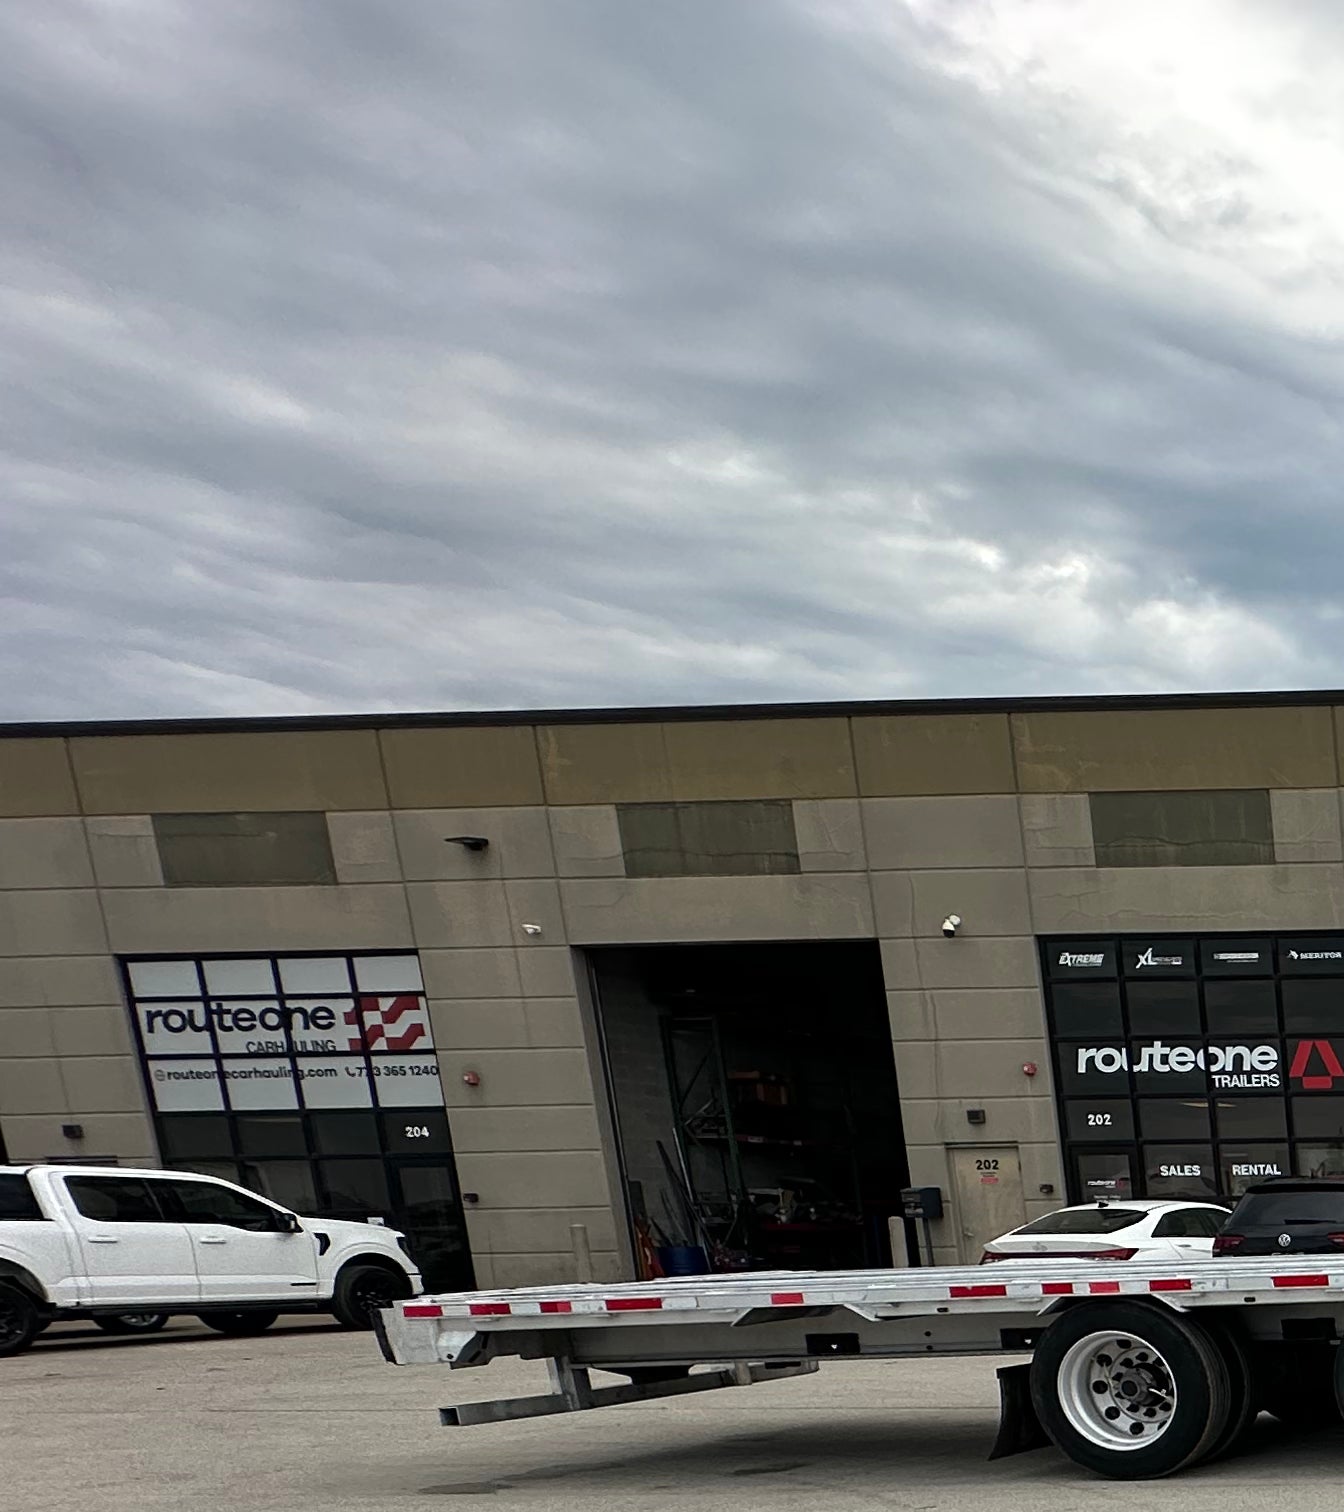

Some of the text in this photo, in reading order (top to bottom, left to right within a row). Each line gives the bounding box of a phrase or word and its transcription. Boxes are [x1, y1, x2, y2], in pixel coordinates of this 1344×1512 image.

[145, 1002, 336, 1034] routeone
[246, 1039, 337, 1053] CARHULING
[1077, 1041, 1279, 1074] routeone
[383, 1066, 407, 1076] 365
[408, 1065, 439, 1076] 1240
[1212, 1073, 1280, 1088] TRAILERS
[1087, 1113, 1112, 1126] 202
[405, 1125, 430, 1138] 204
[975, 1159, 999, 1171] 202
[1159, 1164, 1201, 1177] SALES
[1232, 1163, 1282, 1176] RENTAL
